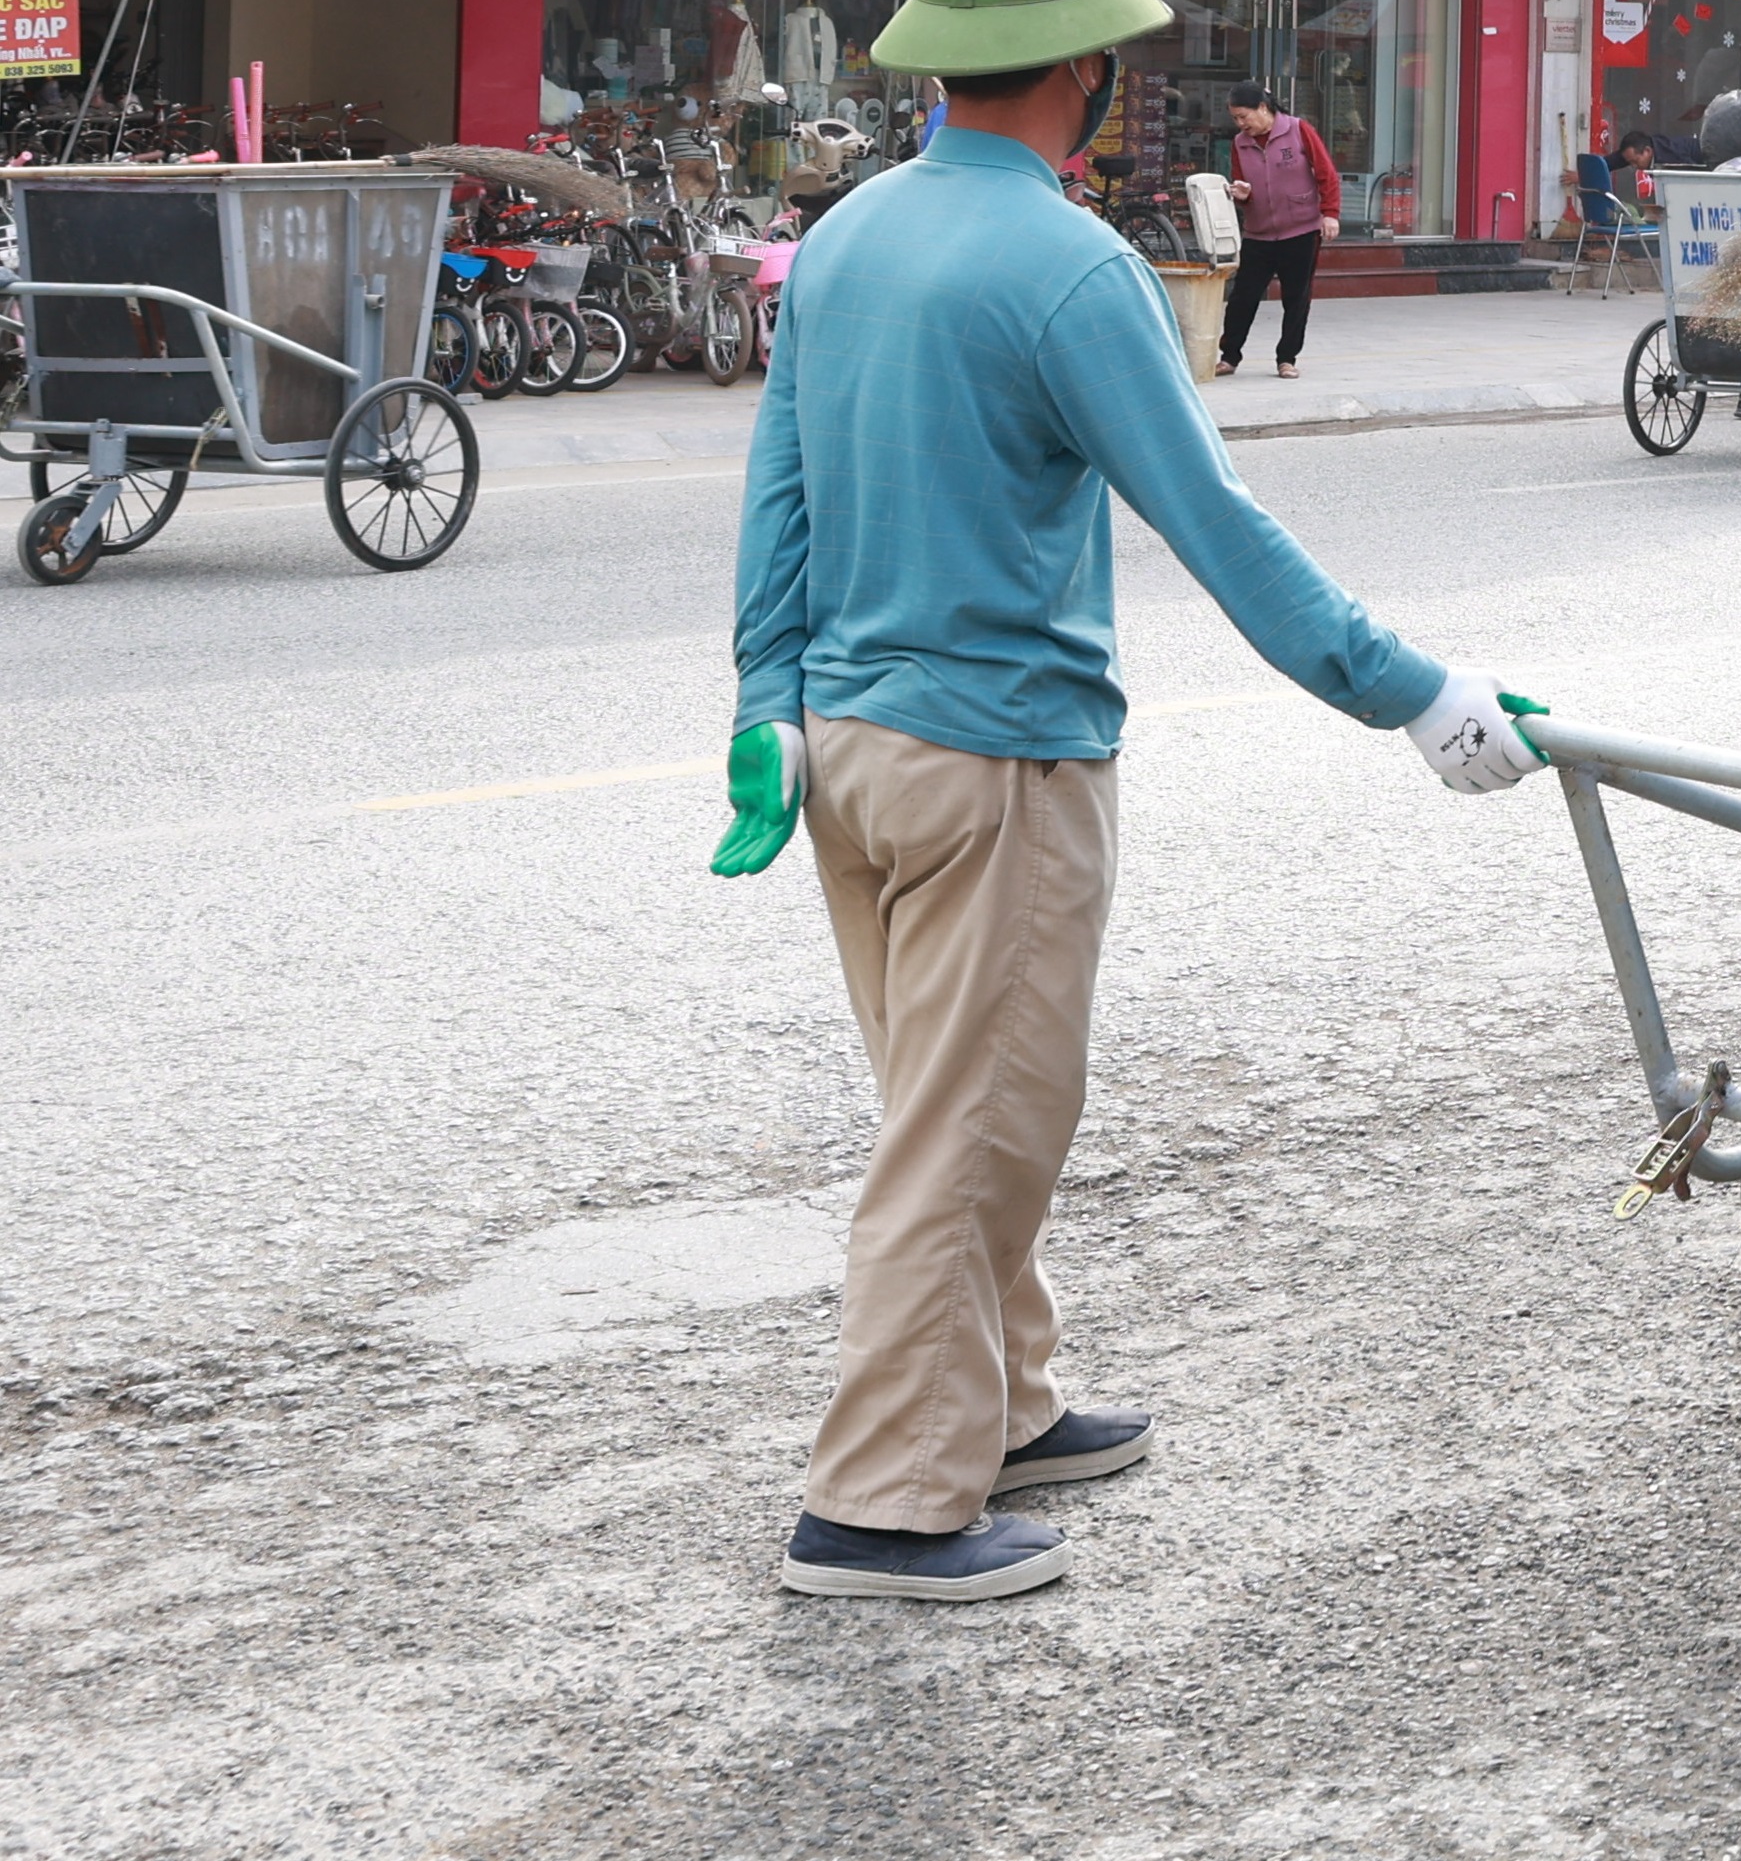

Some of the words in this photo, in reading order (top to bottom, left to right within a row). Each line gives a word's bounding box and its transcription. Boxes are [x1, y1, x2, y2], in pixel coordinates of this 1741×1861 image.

[15, 16, 68, 44] ĐẠP
[1689, 202, 1704, 232] VÌ
[1706, 202, 1735, 232] MÔI
